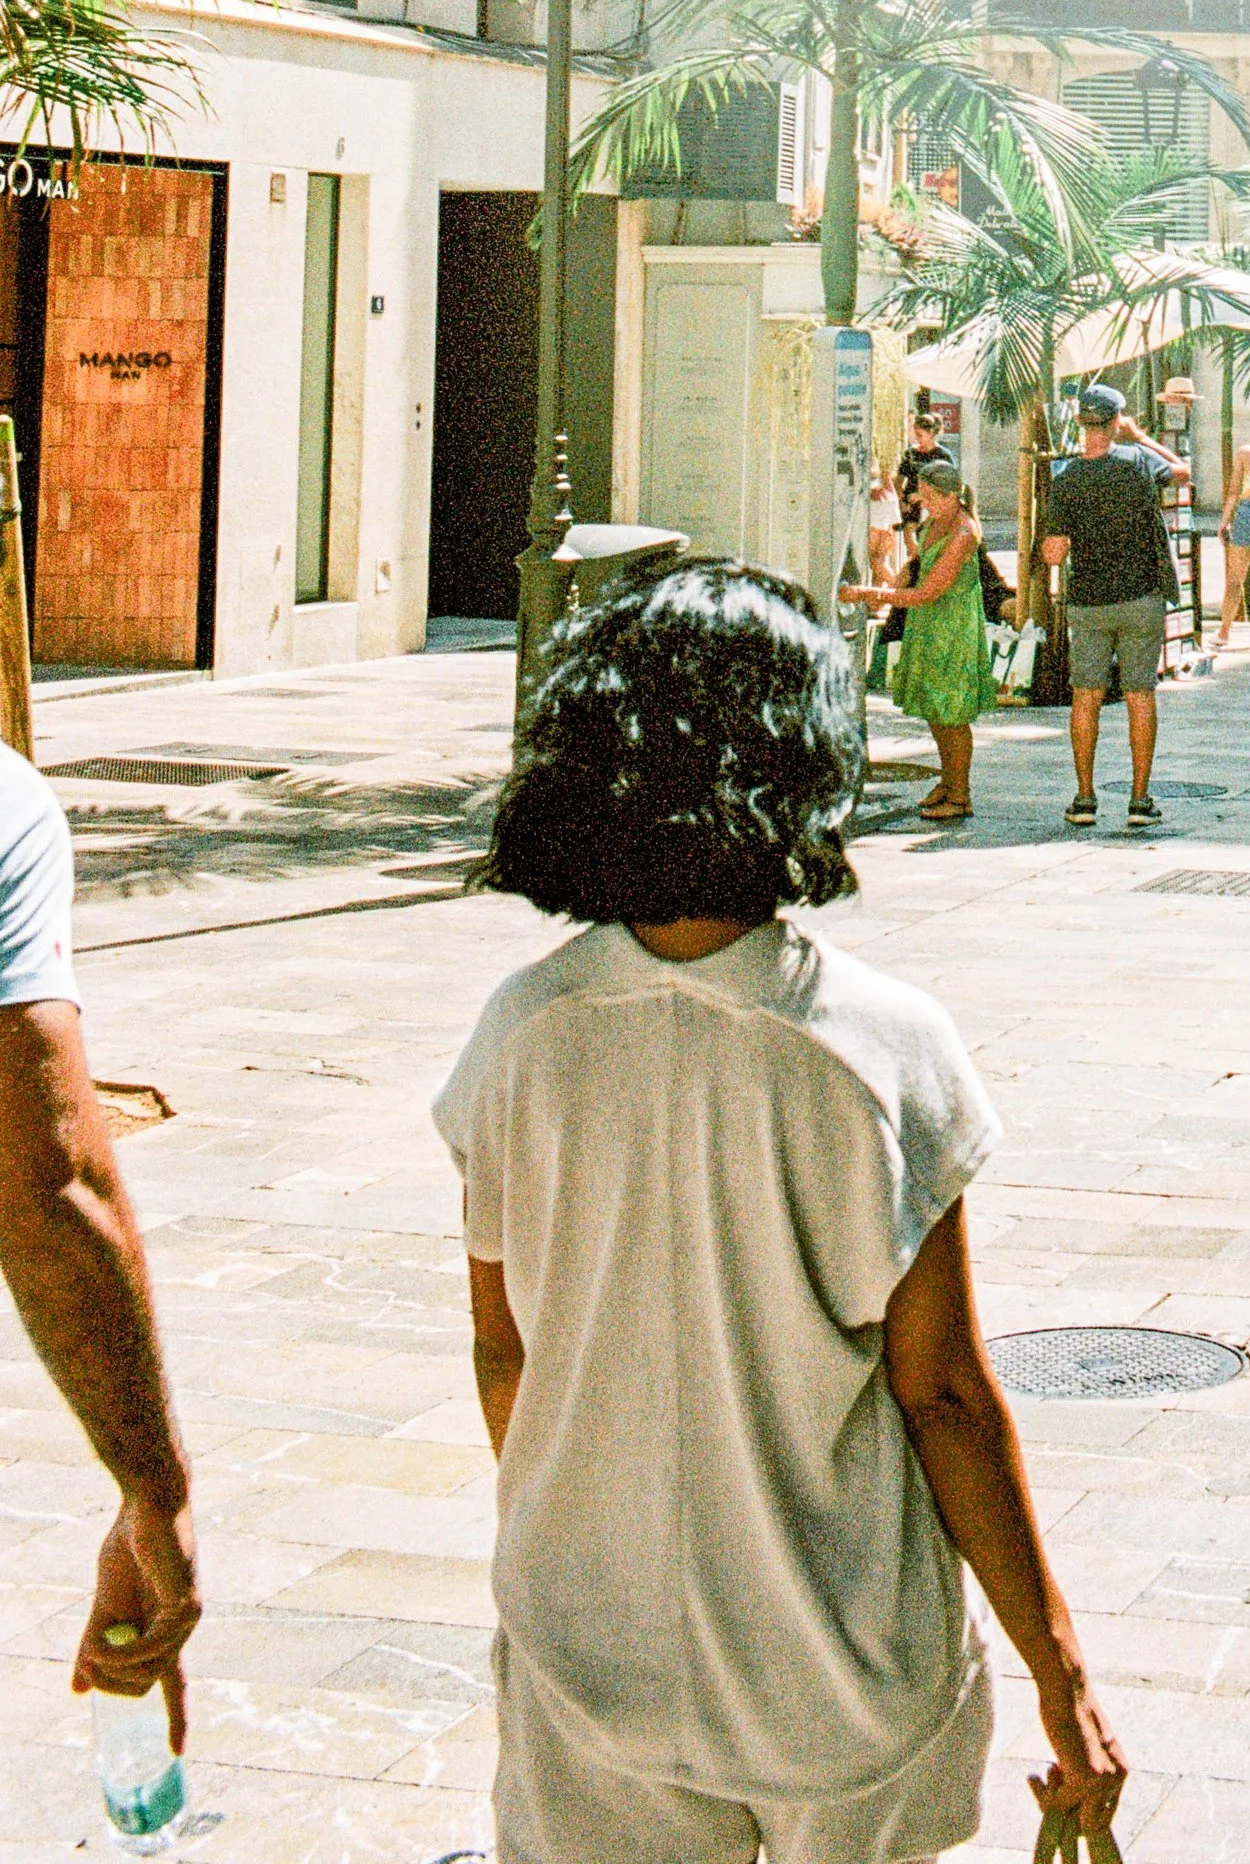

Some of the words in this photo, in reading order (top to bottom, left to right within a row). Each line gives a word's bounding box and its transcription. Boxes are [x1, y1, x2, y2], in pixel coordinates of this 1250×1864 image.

[37, 178, 79, 200] MAN
[79, 351, 172, 369] MANGO
[110, 370, 141, 380] MAN
